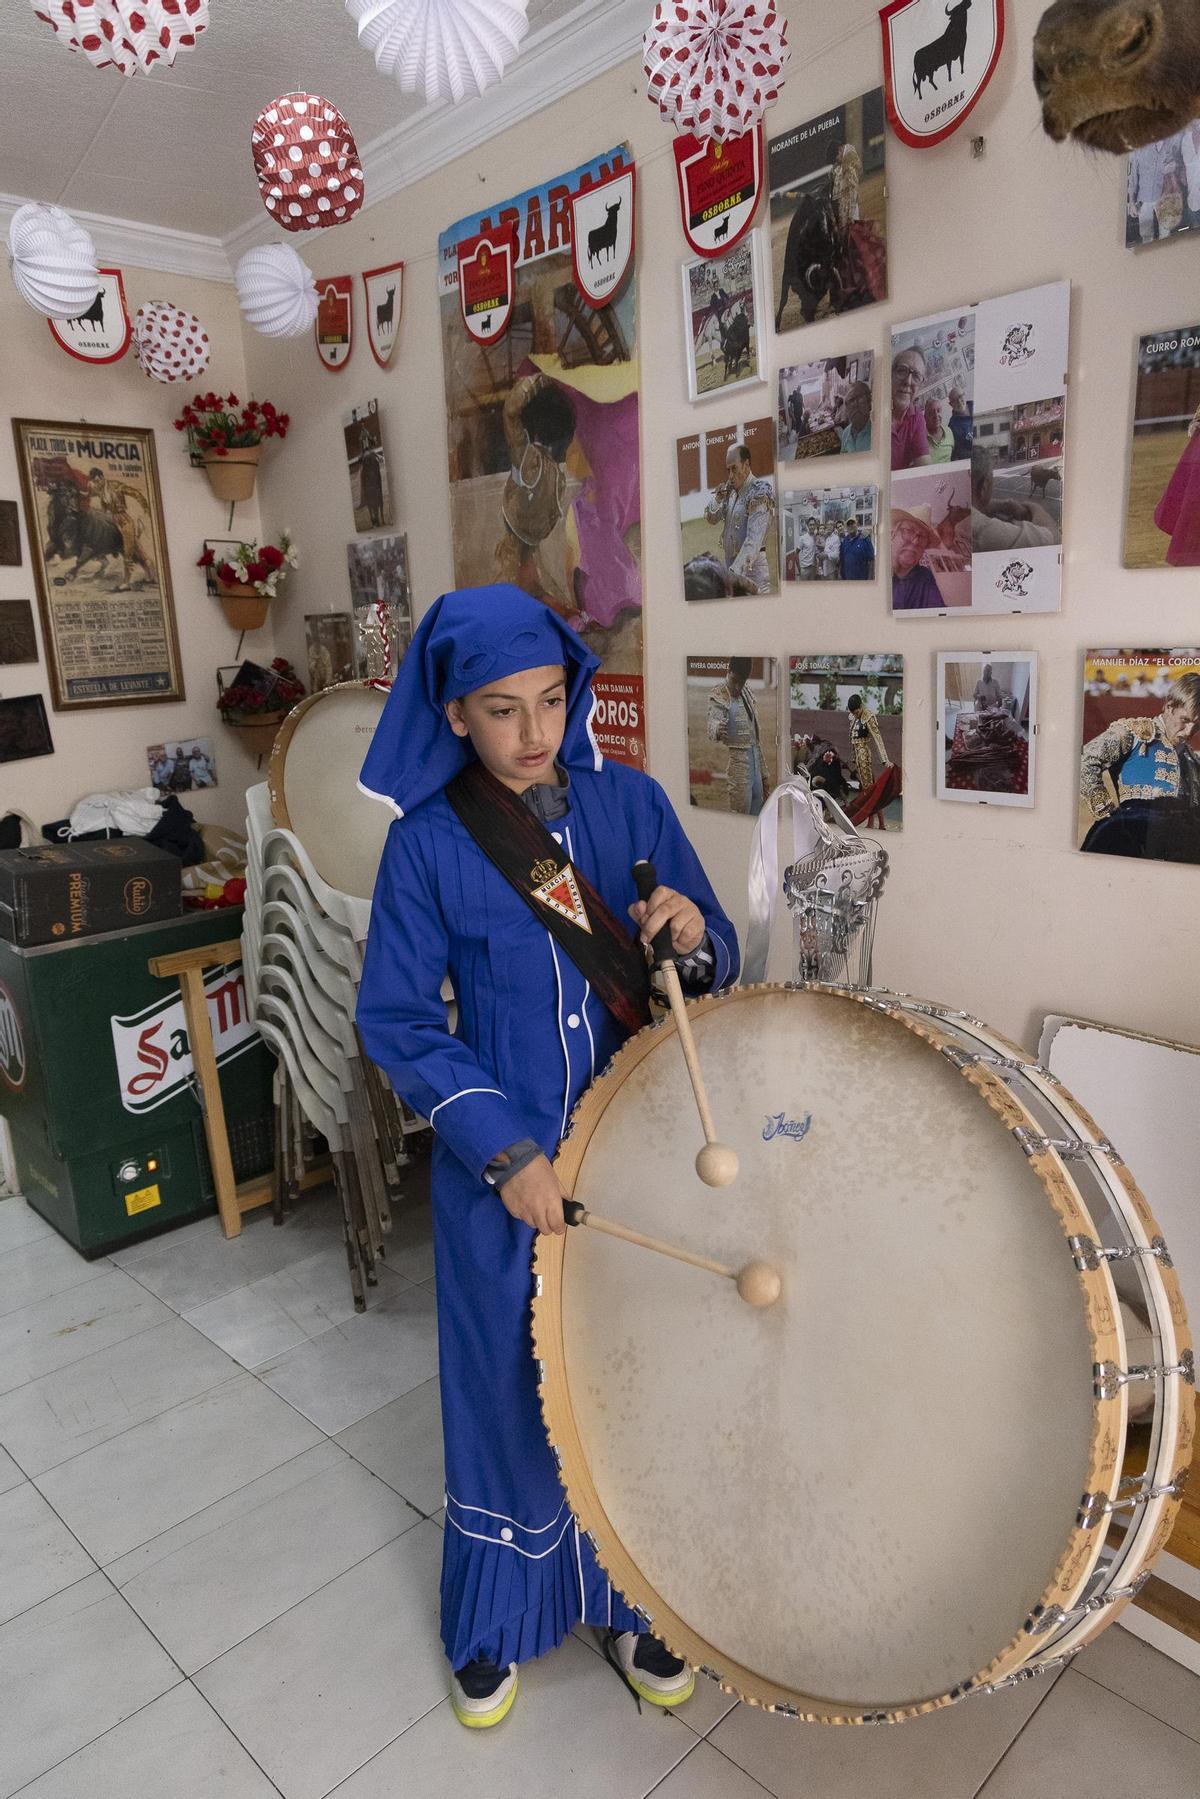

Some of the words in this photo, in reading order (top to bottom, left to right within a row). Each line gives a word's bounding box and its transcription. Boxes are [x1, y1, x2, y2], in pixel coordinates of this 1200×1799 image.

[924, 90, 966, 123] OSBORNE
[771, 134, 799, 154] MORANTE
[800, 130, 808, 141] DE
[809, 126, 817, 137] LA
[818, 116, 840, 133] PUEBLA
[702, 192, 742, 221] OSBORNE
[1146, 340, 1178, 354] CURRO
[76, 440, 141, 461] MURCIA
[1092, 657, 1127, 666] MANUEL
[1129, 655, 1149, 666] DÍAZ
[597, 683, 610, 692] SAN
[596, 699, 639, 728] OROS
[541, 874, 566, 893] MURCIA
[69, 873, 82, 933] PREMIUM
[546, 897, 578, 920] CLUB
